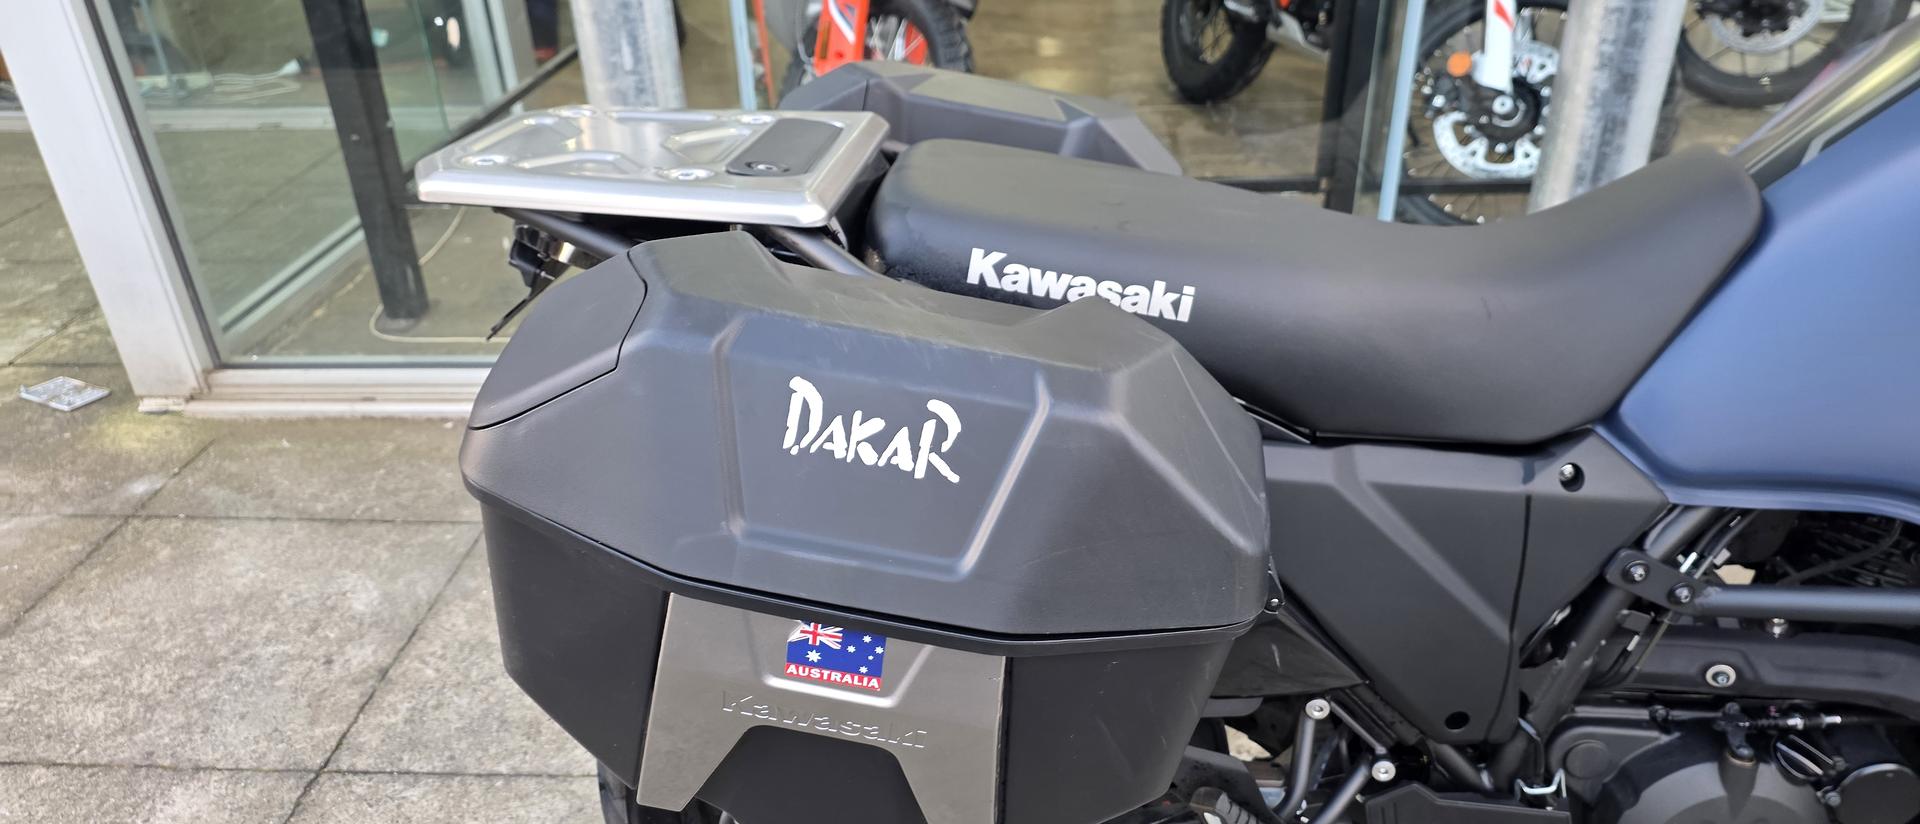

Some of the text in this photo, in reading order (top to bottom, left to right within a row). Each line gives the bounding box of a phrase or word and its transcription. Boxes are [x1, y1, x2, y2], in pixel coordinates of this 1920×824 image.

[966, 248, 1195, 322] Kawasaki
[783, 376, 961, 483] DAKAR
[786, 664, 880, 688] AUSTRALIA
[723, 691, 928, 748] Kawasaki
